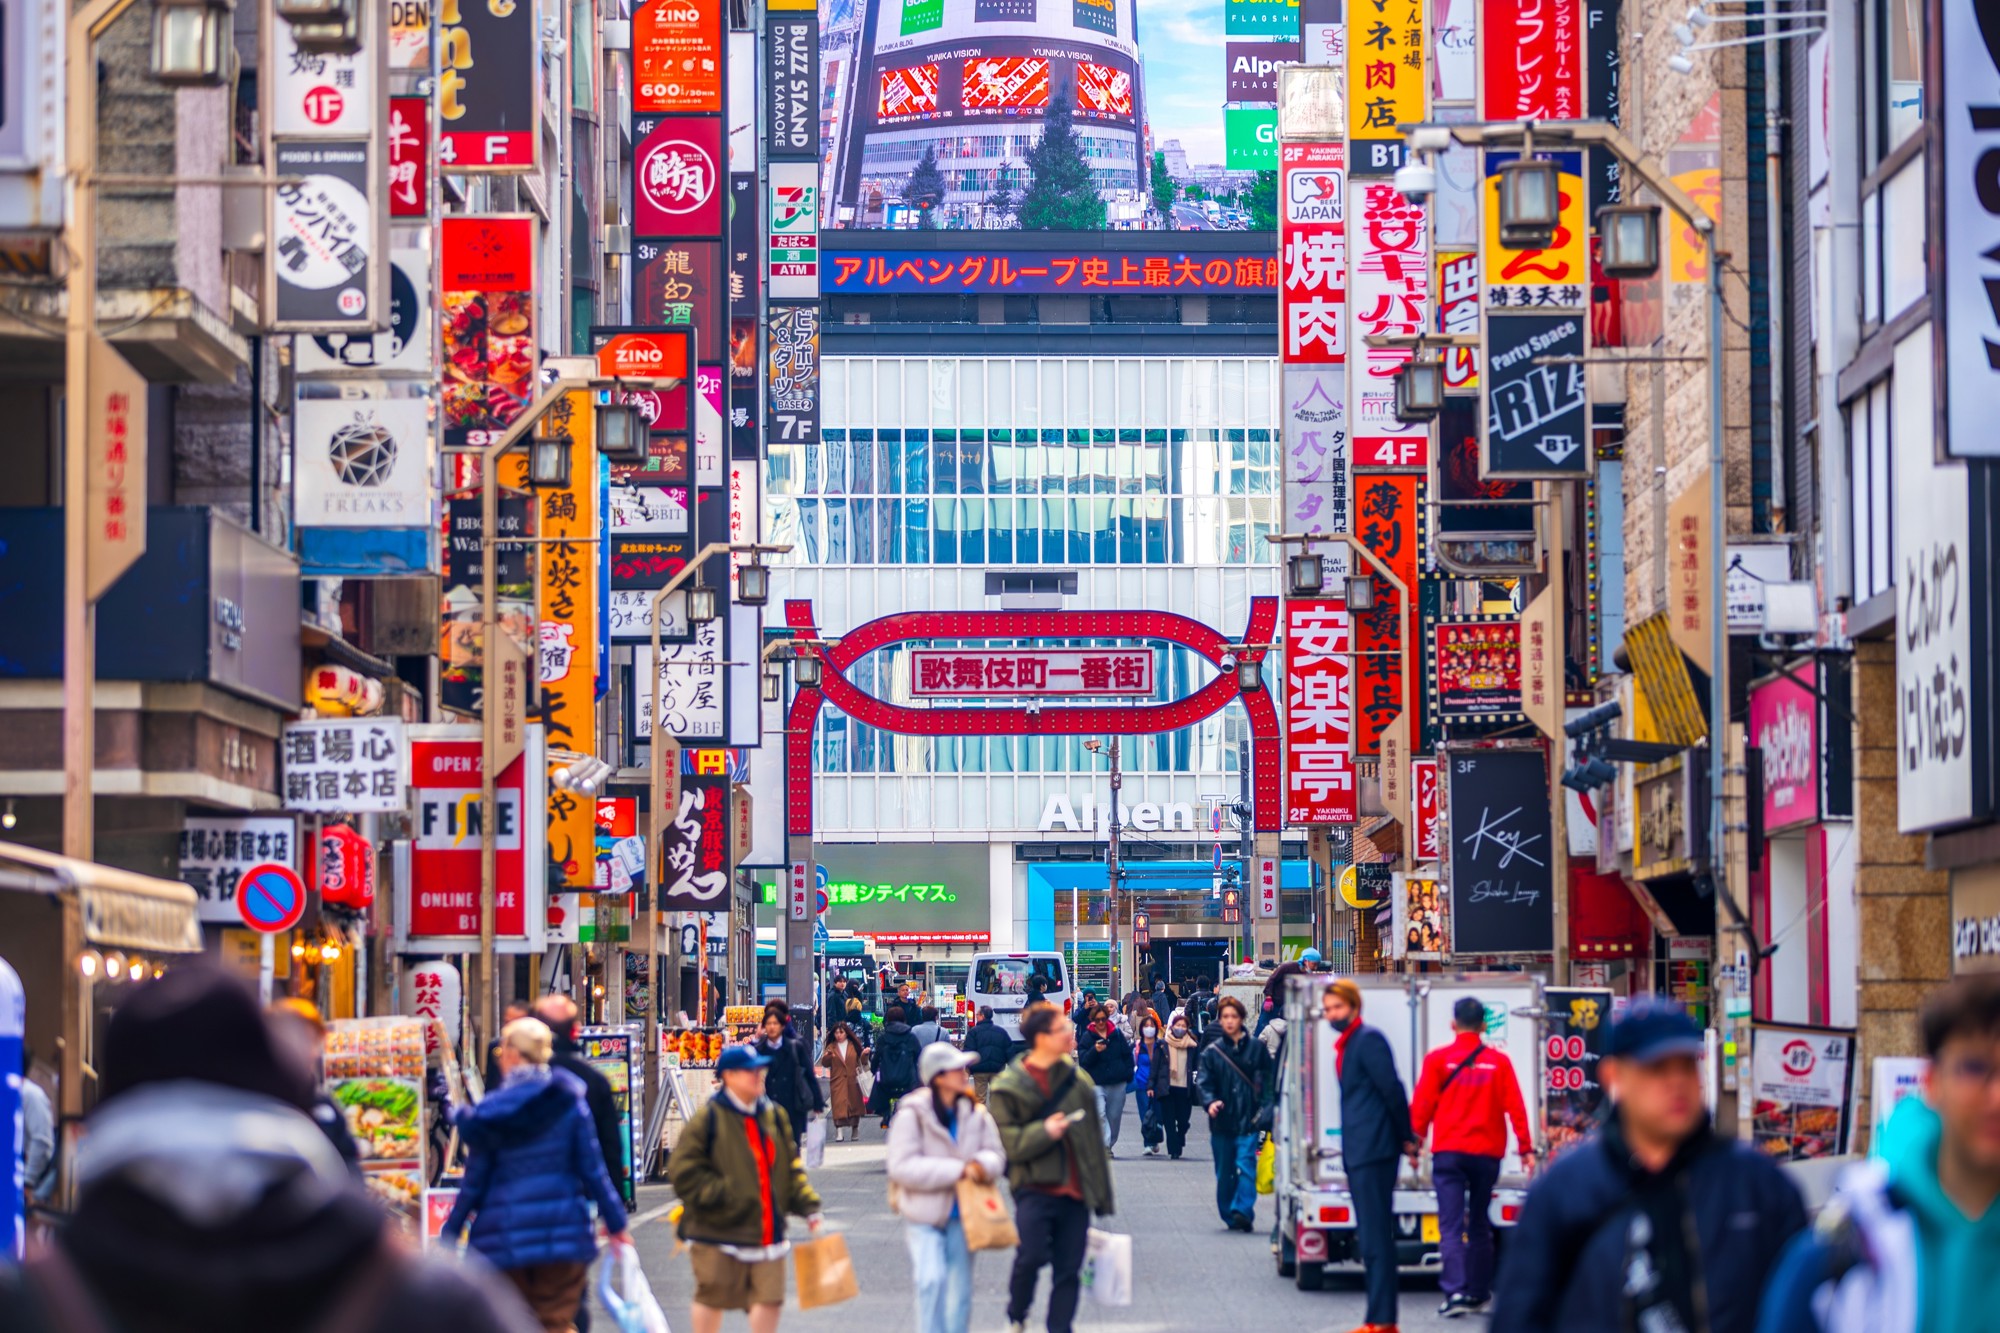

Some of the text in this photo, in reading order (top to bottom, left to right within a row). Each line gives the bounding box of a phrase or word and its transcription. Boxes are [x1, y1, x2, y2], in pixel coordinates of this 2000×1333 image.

[654, 9, 700, 22] ZINO
[774, 26, 786, 66] DARTS
[926, 48, 982, 63] YUNIKA VISION
[1032, 48, 1093, 62] YUNIKA VISION
[790, 25, 809, 148] BUZZ STAND
[305, 94, 341, 121] 1F
[774, 84, 786, 147] KARAOKE
[637, 121, 655, 135] 4F
[1284, 148, 1304, 162] 2F
[1371, 144, 1400, 168] B1
[1292, 207, 1342, 220] JAPAN
[777, 236, 810, 247] たばこ
[637, 244, 658, 260] 3F
[786, 250, 801, 261] 酒
[780, 264, 807, 275] ATM
[1285, 231, 1346, 356] 焼肉
[795, 310, 814, 382] ビアポン
[1491, 320, 1577, 372] Party Space
[615, 349, 663, 363] ZINO
[697, 374, 722, 395] 2F
[1294, 412, 1342, 424] RESTAURANT
[776, 415, 813, 440] 7F
[1374, 440, 1418, 465] 4F
[669, 488, 687, 502] 2F
[324, 499, 405, 514] FREAKS
[920, 656, 1145, 690] 歌舞伎町一番街
[1290, 605, 1353, 803] 安楽亭
[692, 721, 721, 734] B1F
[286, 727, 396, 765] 酒場心
[432, 756, 471, 773] OPEN
[1457, 760, 1477, 774] 3F
[286, 768, 398, 802] 新宿本店
[664, 749, 676, 811] 劇場通り一番街
[422, 802, 514, 836] FINE
[1037, 792, 1194, 841] Alpen
[1289, 808, 1309, 822] 2F
[1312, 814, 1353, 822] ANRAKUTEI
[1463, 806, 1545, 869] Key
[793, 864, 805, 916] 劇場通り
[1262, 860, 1274, 913] 劇場通り
[420, 892, 474, 908] ONLINE
[459, 913, 478, 930] B1
[829, 957, 863, 968] 都営バス
